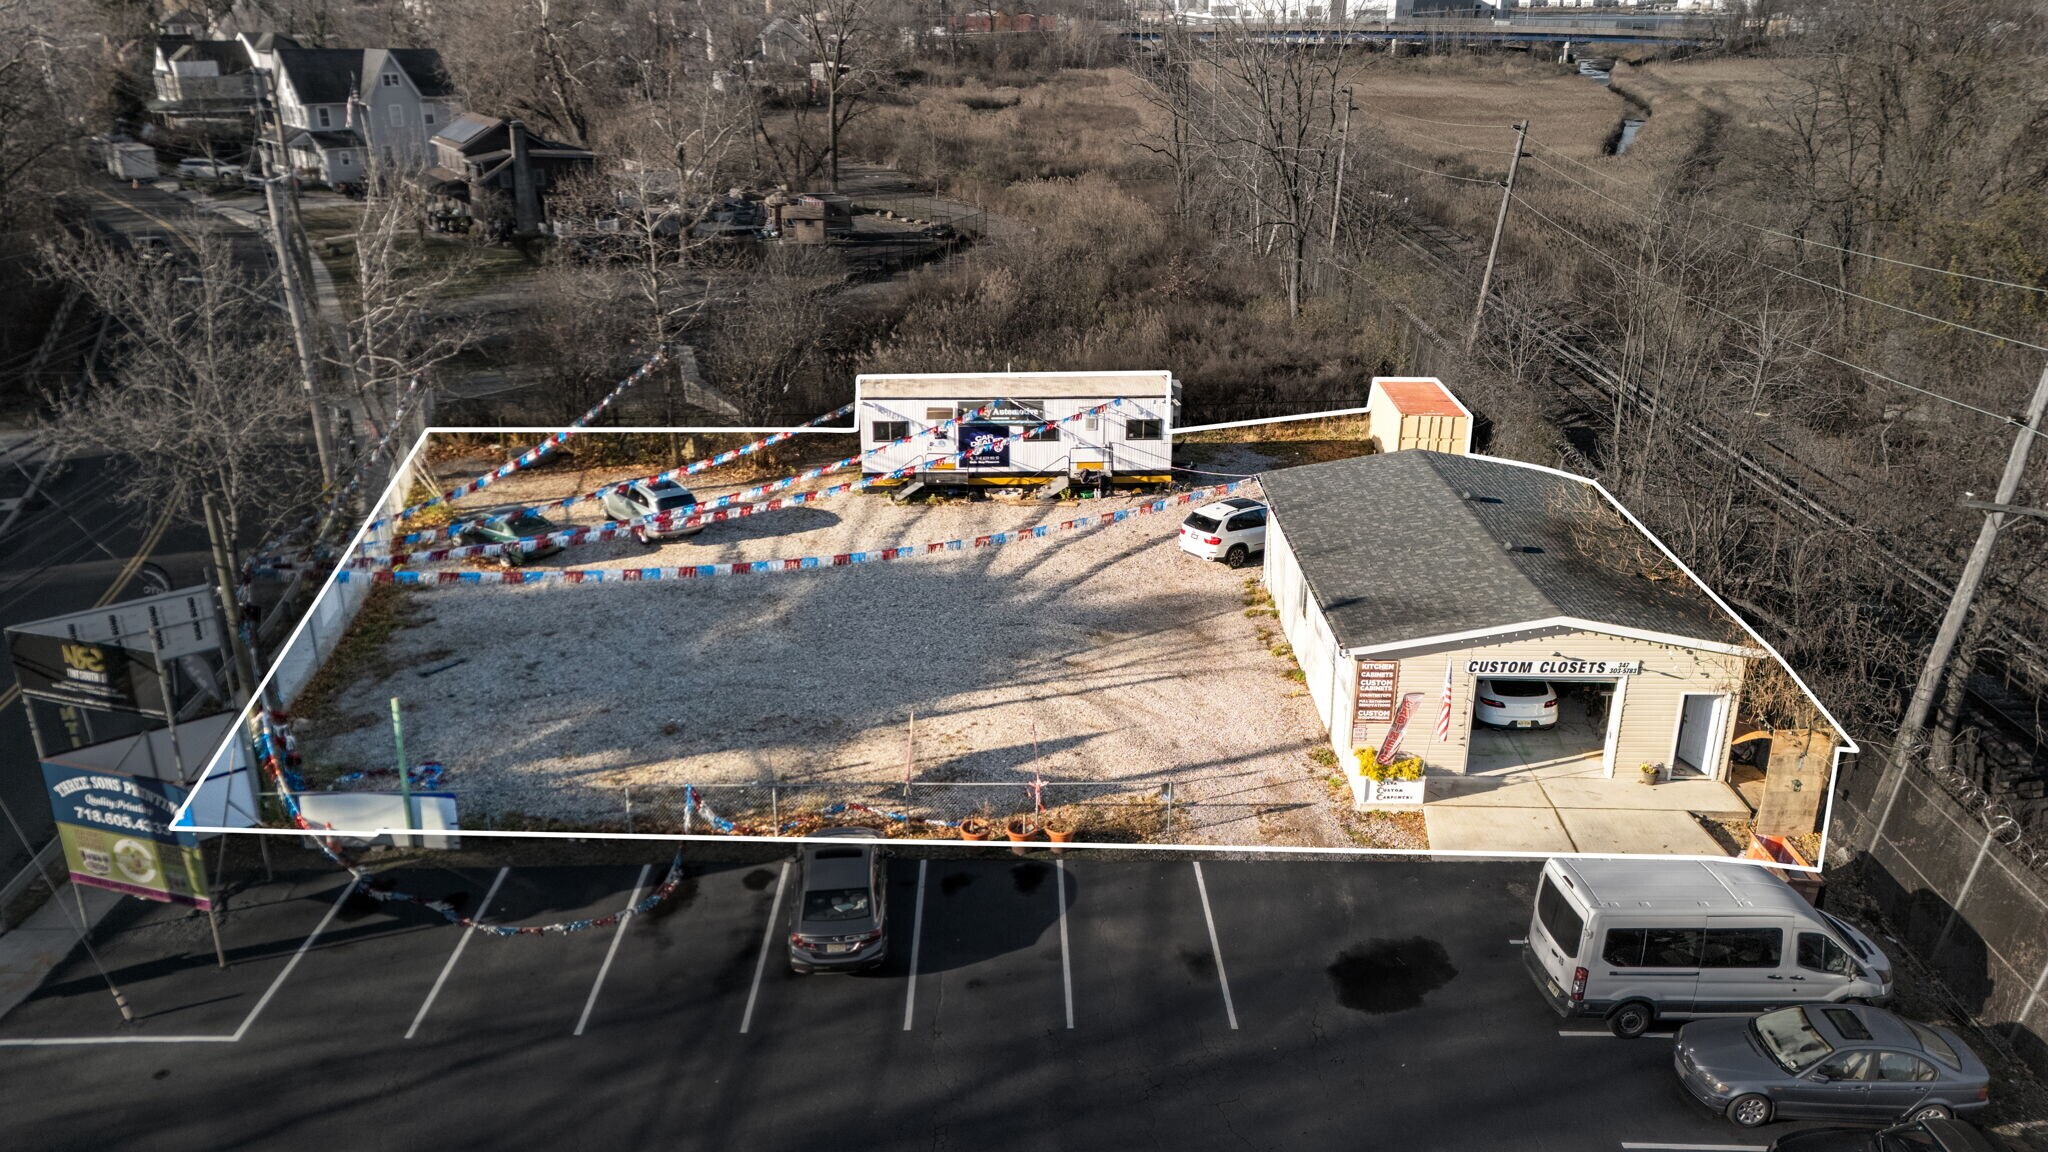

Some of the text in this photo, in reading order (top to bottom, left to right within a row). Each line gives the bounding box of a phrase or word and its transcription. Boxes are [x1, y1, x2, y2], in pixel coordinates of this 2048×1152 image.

[975, 434, 994, 442] CAR
[1468, 660, 1607, 674] CUSTOM CLOSETS
[53, 776, 183, 817] THREE SONS PRINTIN
[84, 793, 116, 810] Quality
